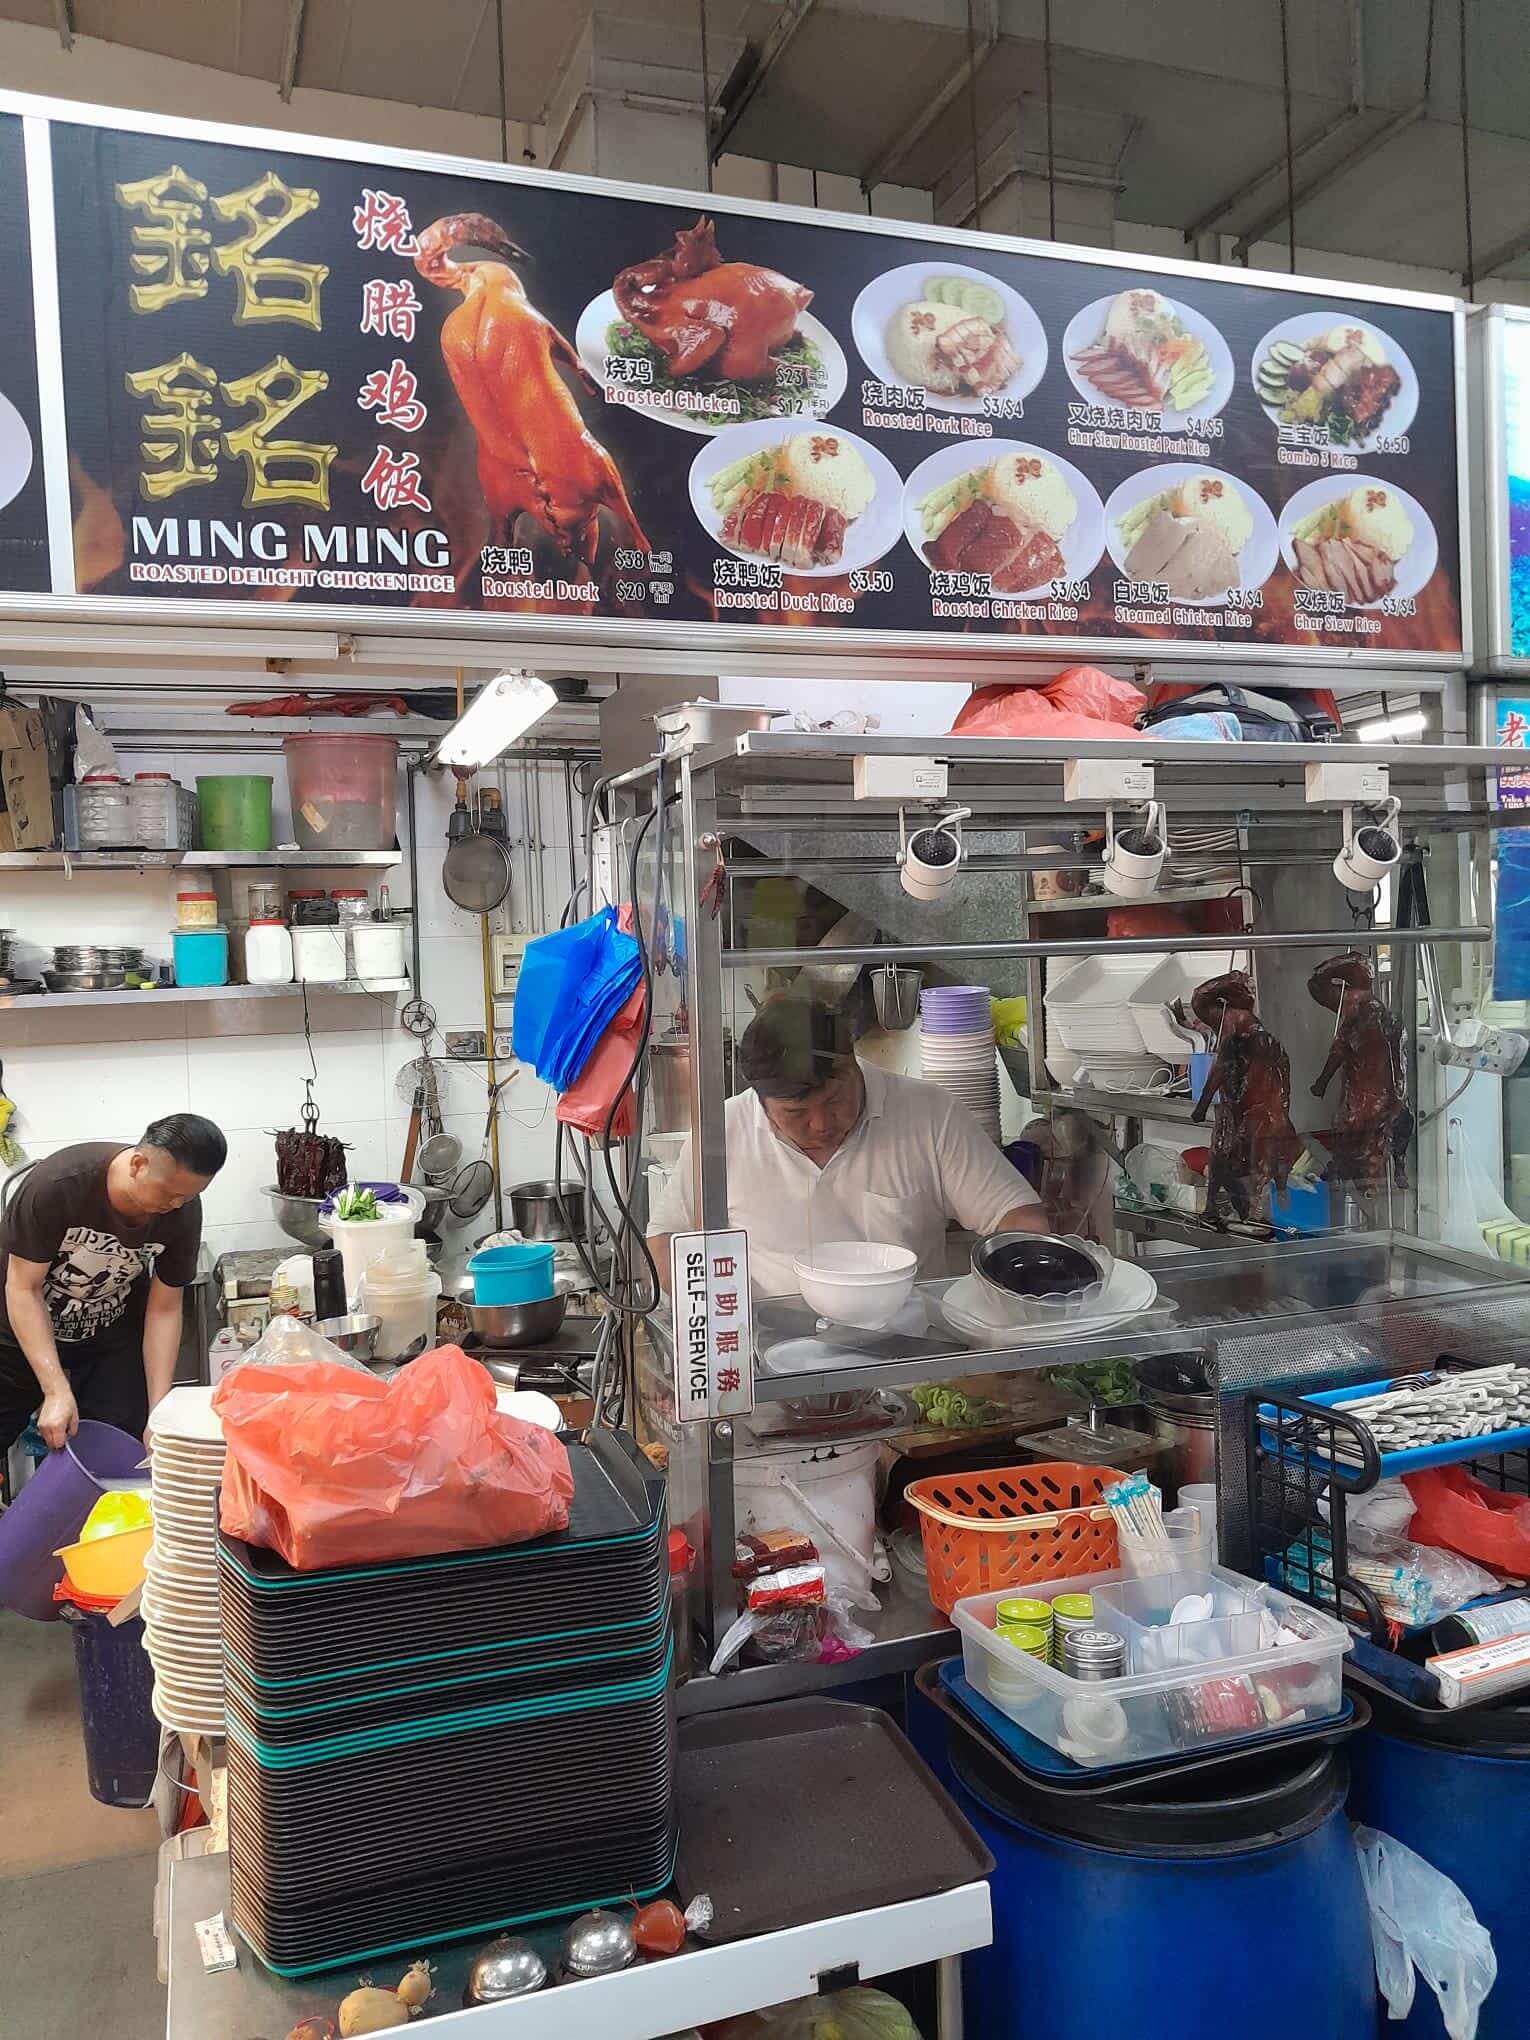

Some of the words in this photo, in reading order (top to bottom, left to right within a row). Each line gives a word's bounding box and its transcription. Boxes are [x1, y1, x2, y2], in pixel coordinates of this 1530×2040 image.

[352, 188, 431, 513] 烧腊鸡饭
[603, 356, 651, 384] 烧鸡
[605, 386, 674, 407] Roasted
[676, 391, 741, 414] Chicken
[862, 380, 927, 410] 烧肉饭
[983, 395, 1024, 420] $3/$4
[863, 408, 923, 431] Roasted
[926, 414, 961, 435] Pork
[961, 418, 993, 437] Rice
[1068, 403, 1162, 433] 叉烧烧肉饭
[1121, 434, 1162, 453] Roasted
[1164, 437, 1187, 455] Pork
[1188, 439, 1210, 456] Rice
[1278, 423, 1329, 447] 三宝饭
[1376, 434, 1410, 454] $6.50
[1278, 447, 1319, 466] Combo
[1330, 452, 1358, 469] Rice
[132, 516, 288, 560] MING
[303, 524, 451, 567] MING
[481, 546, 533, 575] 烧鸭
[614, 548, 644, 570] $38
[131, 563, 226, 583] ROASTED
[230, 567, 317, 587] DELIGHT
[317, 569, 409, 590] CHICKEN
[409, 574, 455, 592] RICE
[713, 559, 783, 588] 烧鸭饭
[850, 568, 894, 592] $3.50
[929, 571, 992, 597] 烧鸡饭
[482, 576, 553, 599] Roasted
[557, 580, 600, 601] Duck
[616, 579, 645, 602] $20
[714, 588, 778, 610] Roasted
[781, 591, 820, 612] Duck
[821, 593, 855, 613] Rice
[1050, 578, 1091, 601] $3/$4
[1113, 580, 1169, 605] 白鸡饭
[1226, 586, 1264, 609] $3/$4
[1294, 589, 1345, 613] 叉烧饭
[932, 598, 989, 618] Roasted
[991, 600, 1046, 620] Chicken
[1048, 601, 1078, 620] Rice
[1115, 605, 1171, 624] Steamed
[1173, 608, 1223, 627] Chicken
[1224, 610, 1252, 627] Rice
[1382, 594, 1416, 617] $3/$4
[1294, 614, 1324, 631] Char
[1355, 616, 1381, 633] Rice
[686, 1252, 707, 1401] SELF-SERVICE
[713, 1256, 741, 1392] 自助服務
